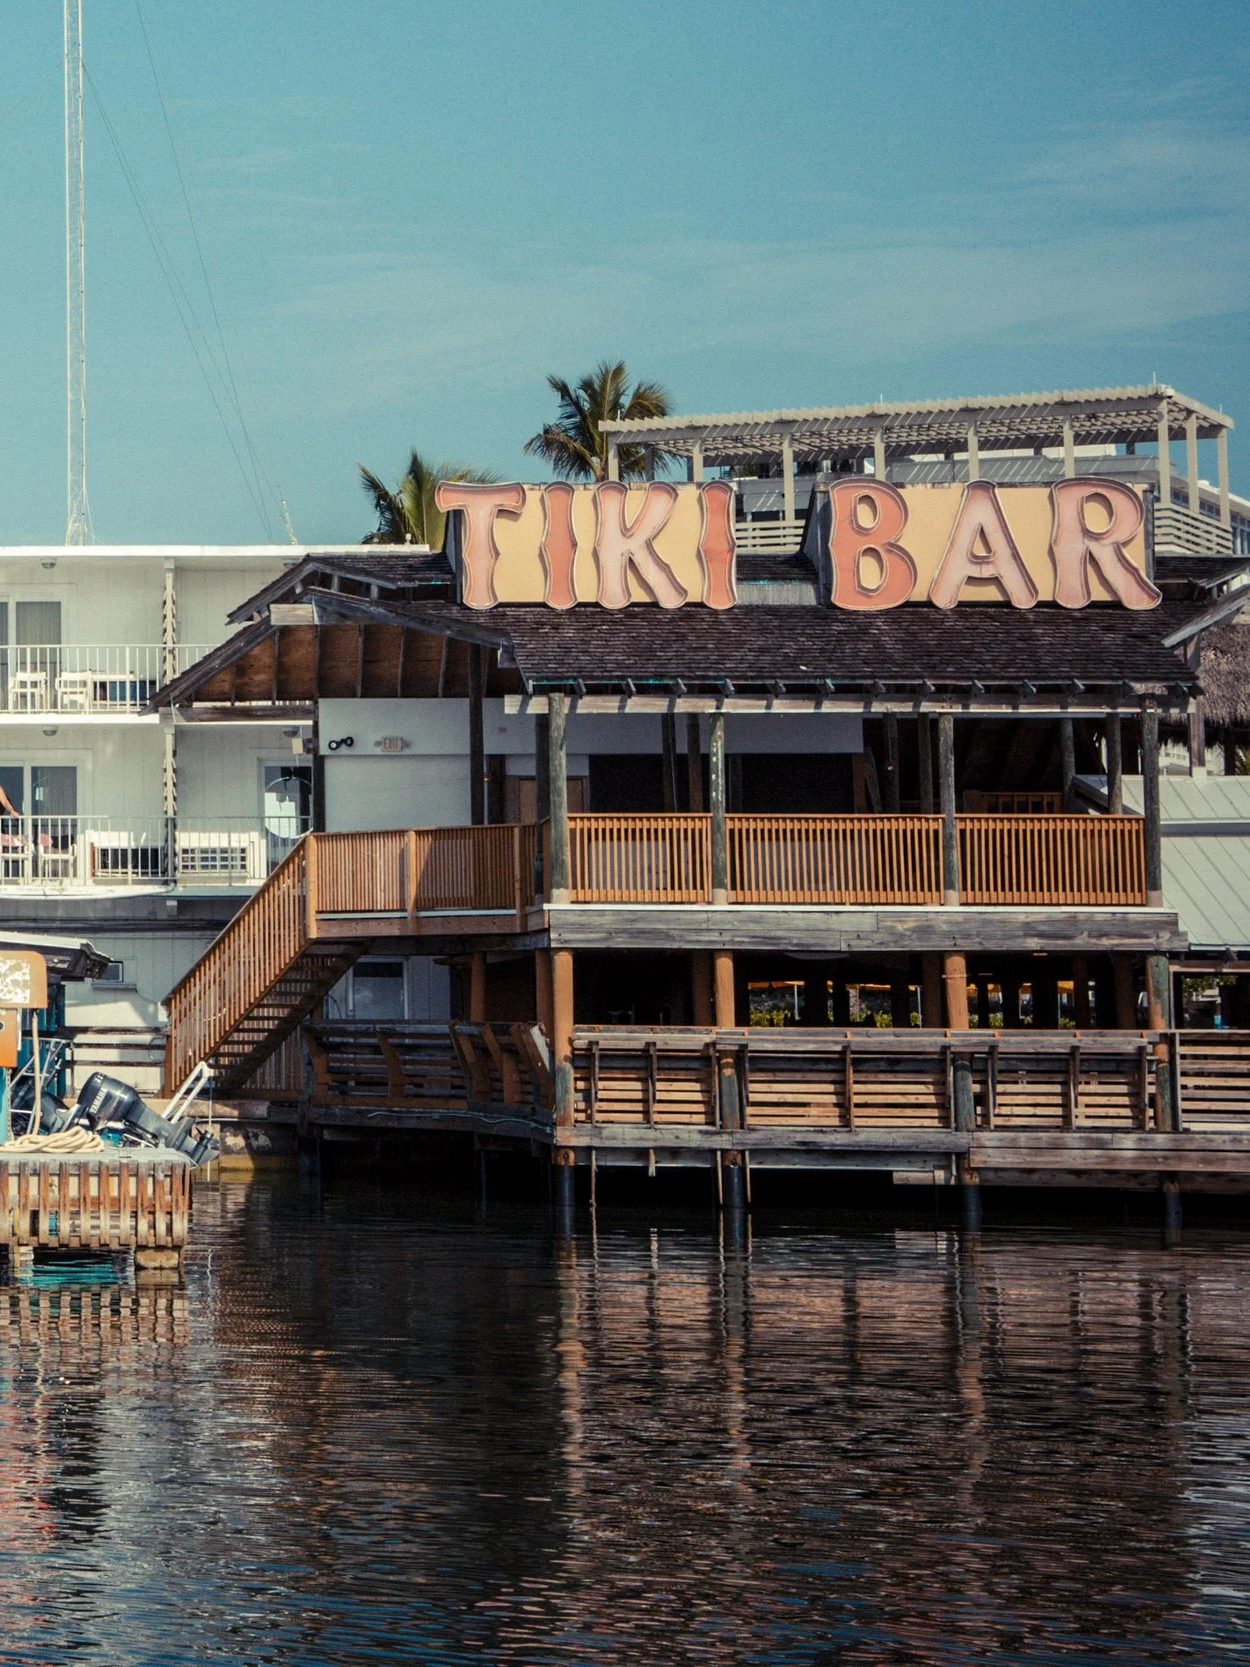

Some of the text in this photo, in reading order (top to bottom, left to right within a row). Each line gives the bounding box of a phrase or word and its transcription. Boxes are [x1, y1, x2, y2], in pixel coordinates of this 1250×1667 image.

[435, 477, 1163, 611] TIKI BAR
[90, 1088, 108, 1113] YAMAHA
